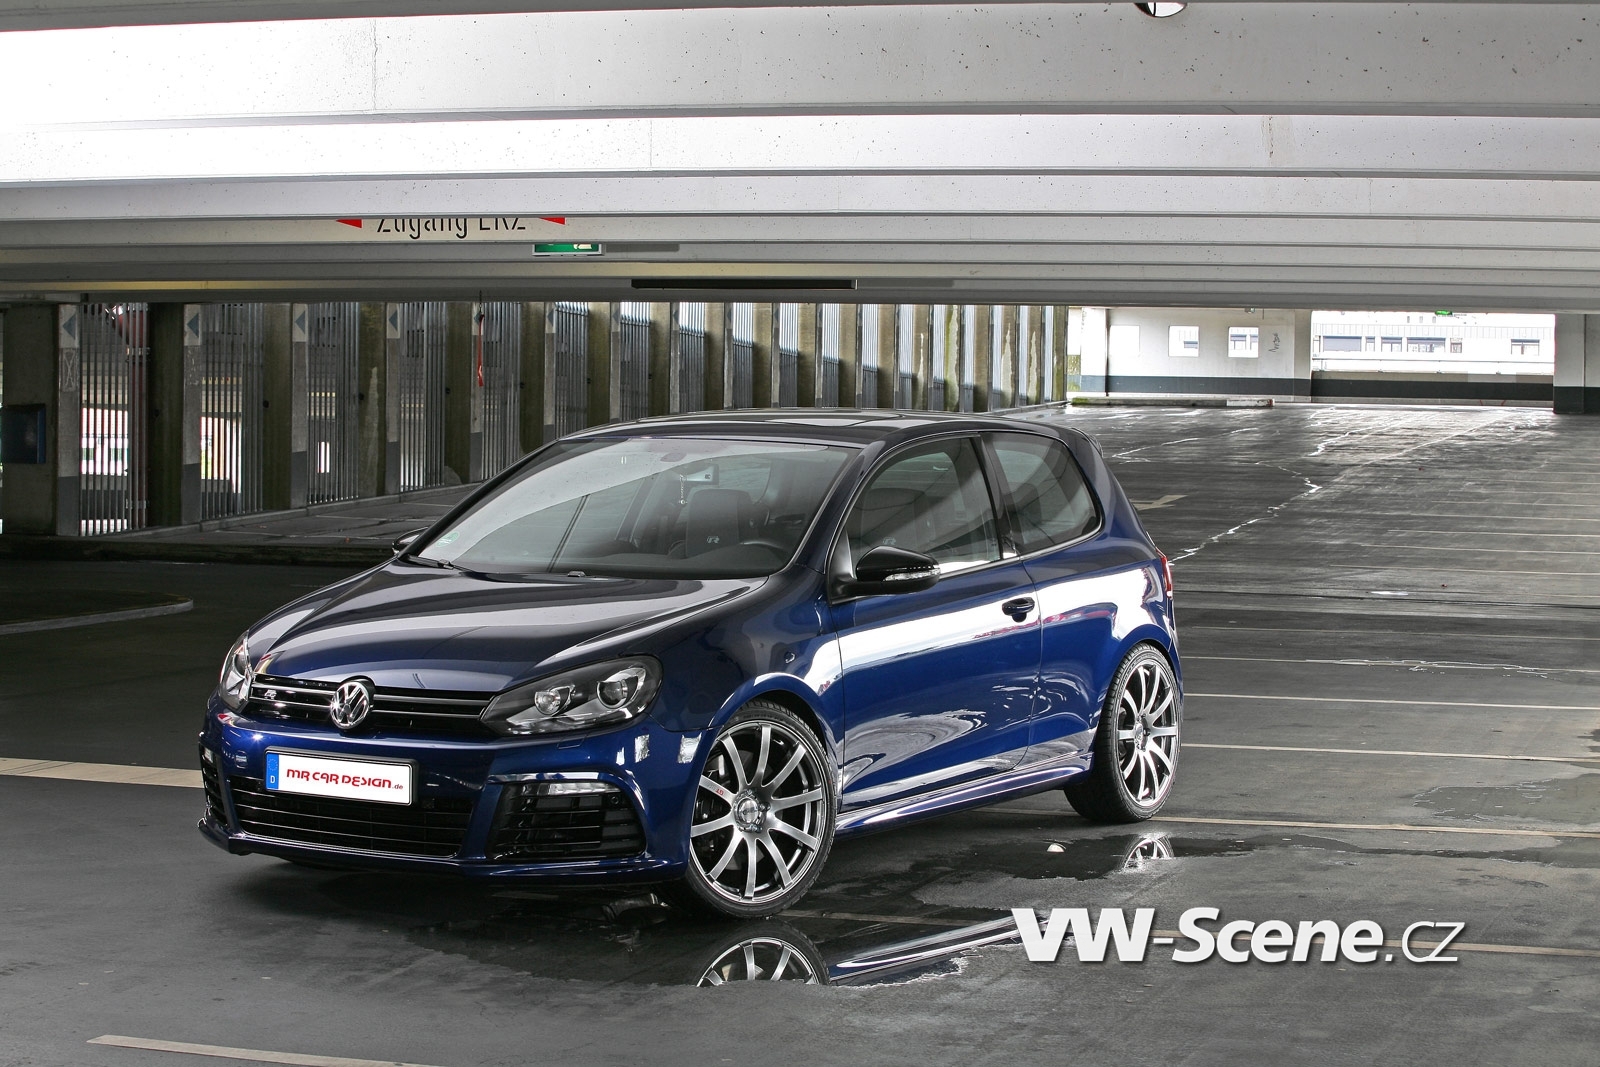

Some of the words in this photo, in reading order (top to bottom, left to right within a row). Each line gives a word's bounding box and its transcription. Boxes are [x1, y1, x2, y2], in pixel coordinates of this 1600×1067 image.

[269, 775, 276, 784] D
[286, 768, 310, 781] MR
[312, 771, 339, 785] CAR
